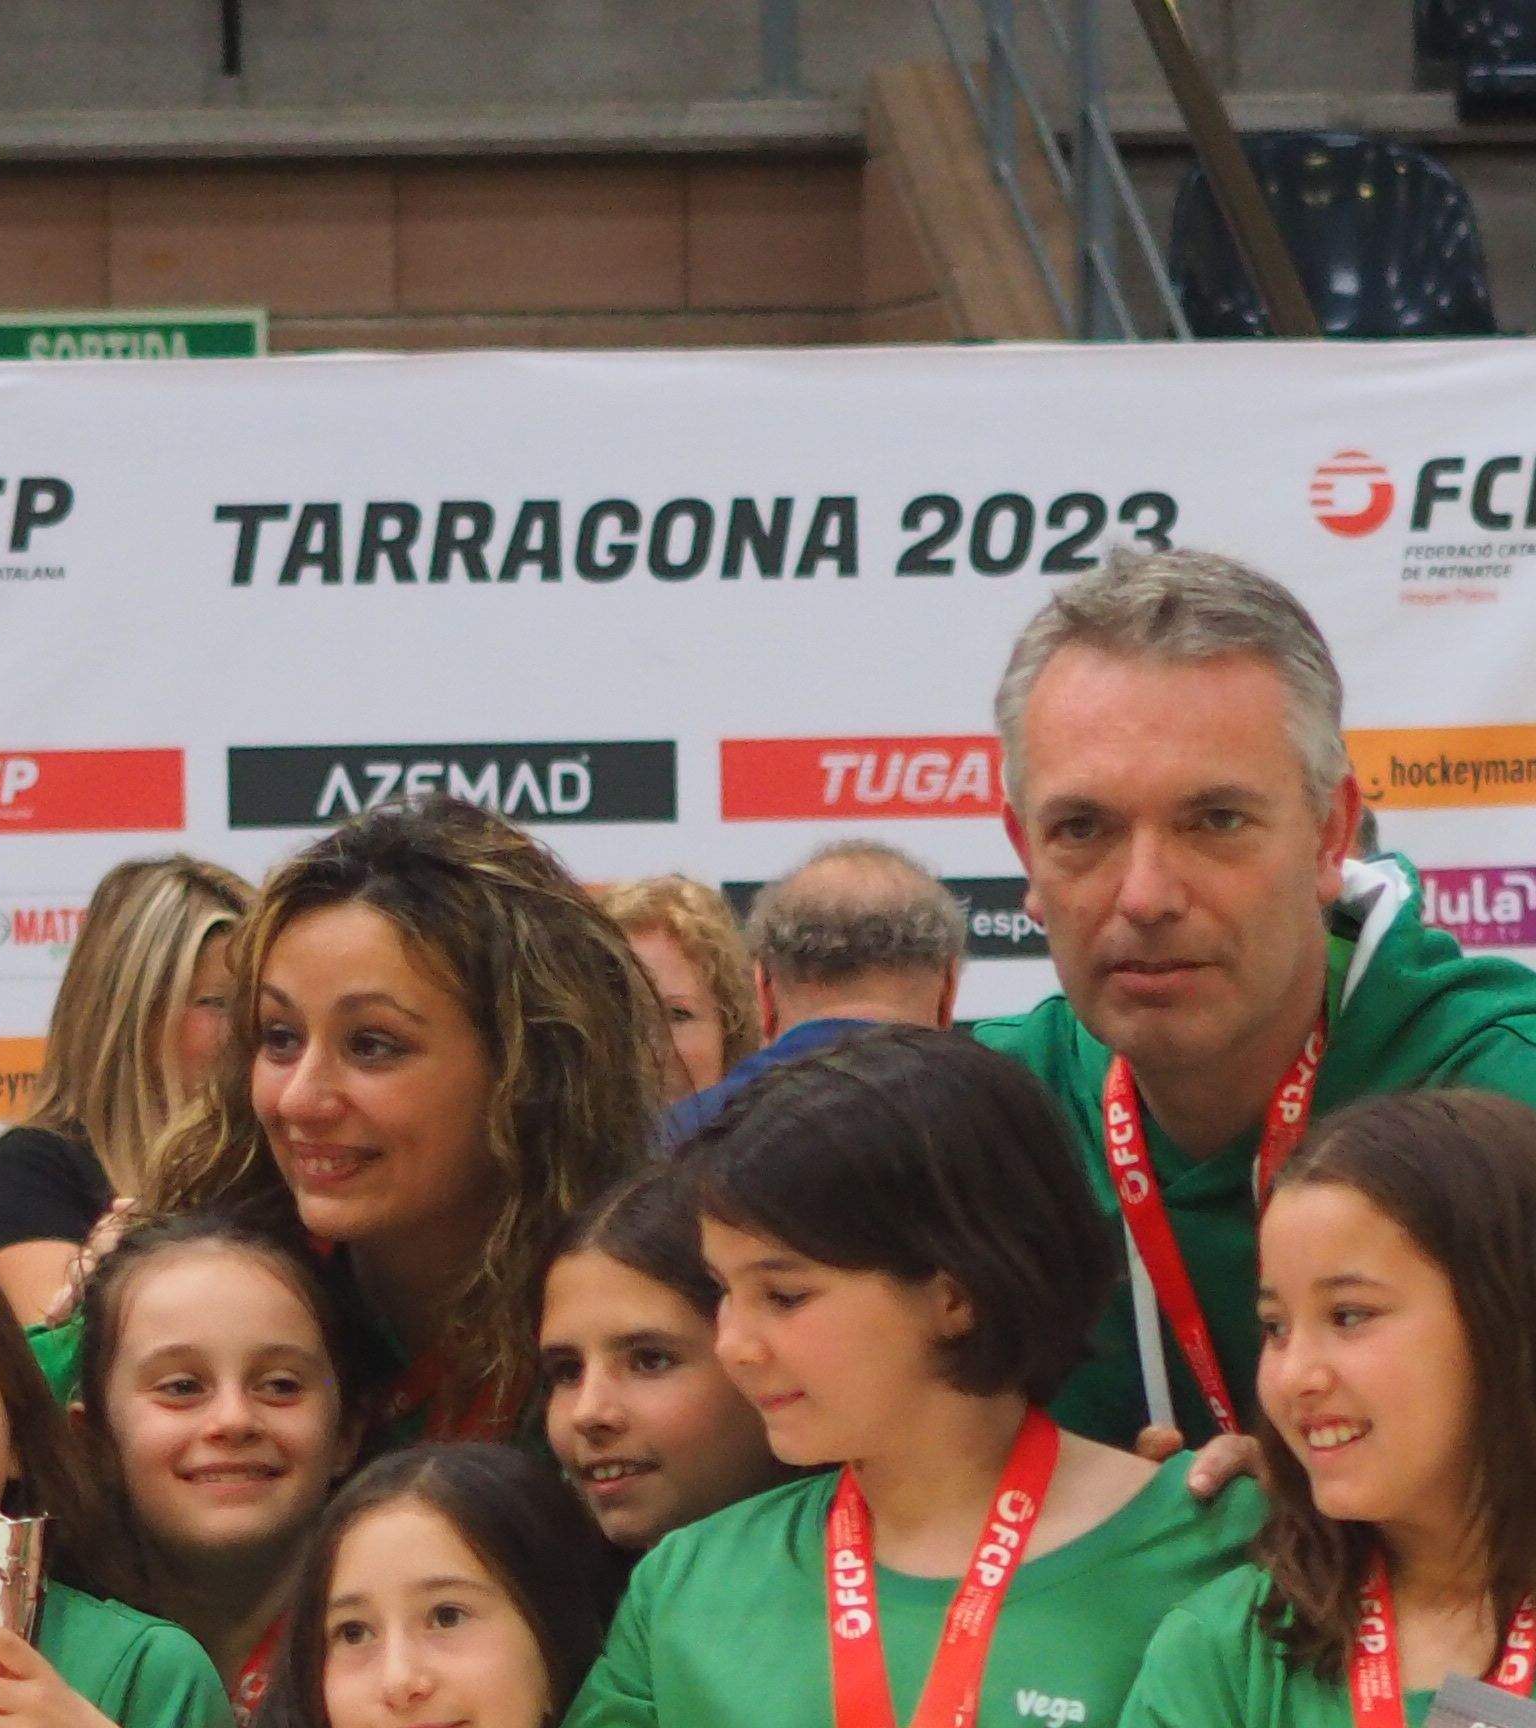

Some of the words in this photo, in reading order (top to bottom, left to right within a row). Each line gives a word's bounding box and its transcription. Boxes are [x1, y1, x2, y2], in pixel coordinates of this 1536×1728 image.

[215, 496, 860, 587] TARRAGONA
[895, 491, 1179, 577] 2023
[820, 751, 993, 804] TUGA
[1108, 1102, 1139, 1167] FCP
[833, 1549, 869, 1607] FCP
[975, 1522, 1020, 1588] FCP
[1016, 1688, 1088, 1728] Vega
